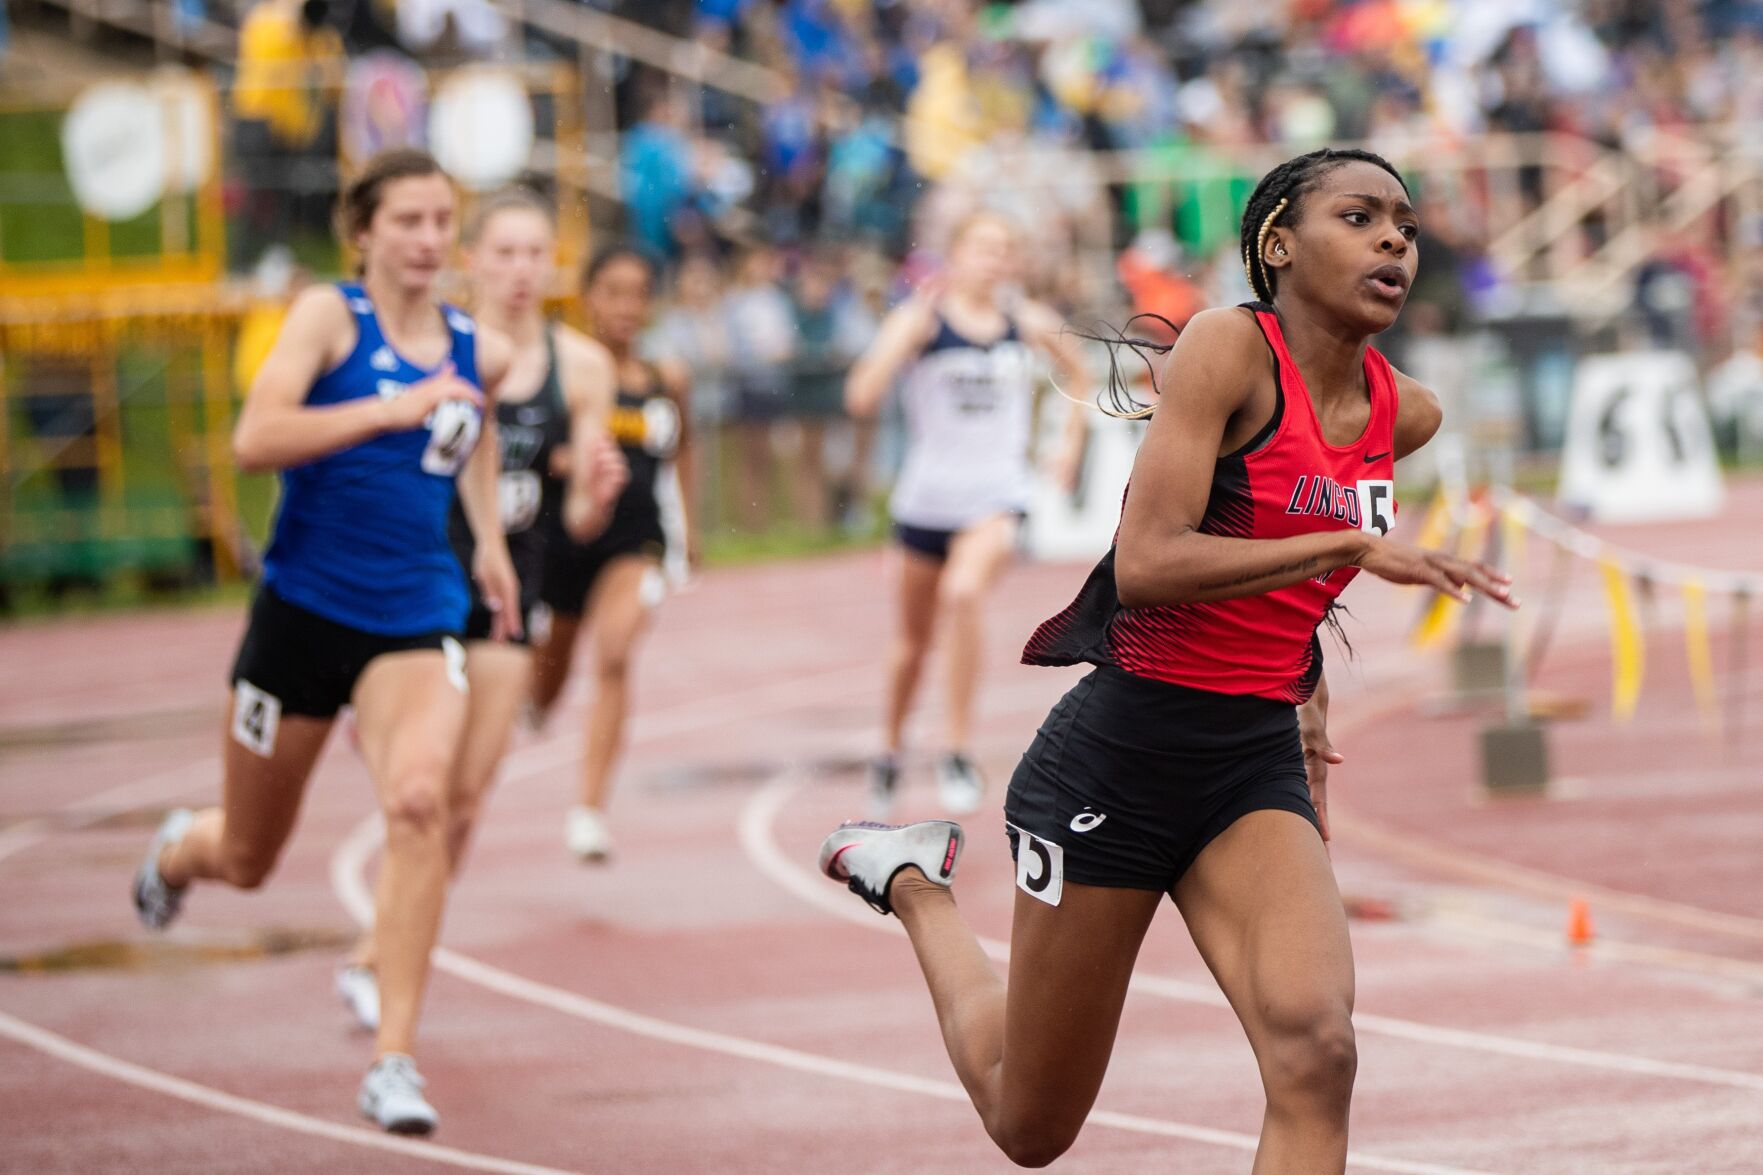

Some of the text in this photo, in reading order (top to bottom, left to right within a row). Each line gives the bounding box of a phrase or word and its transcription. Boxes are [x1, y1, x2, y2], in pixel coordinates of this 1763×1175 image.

[1285, 475, 1360, 528] LINCO
[1368, 485, 1389, 538] 5
[243, 699, 266, 743] 4
[1025, 834, 1052, 893] 5
